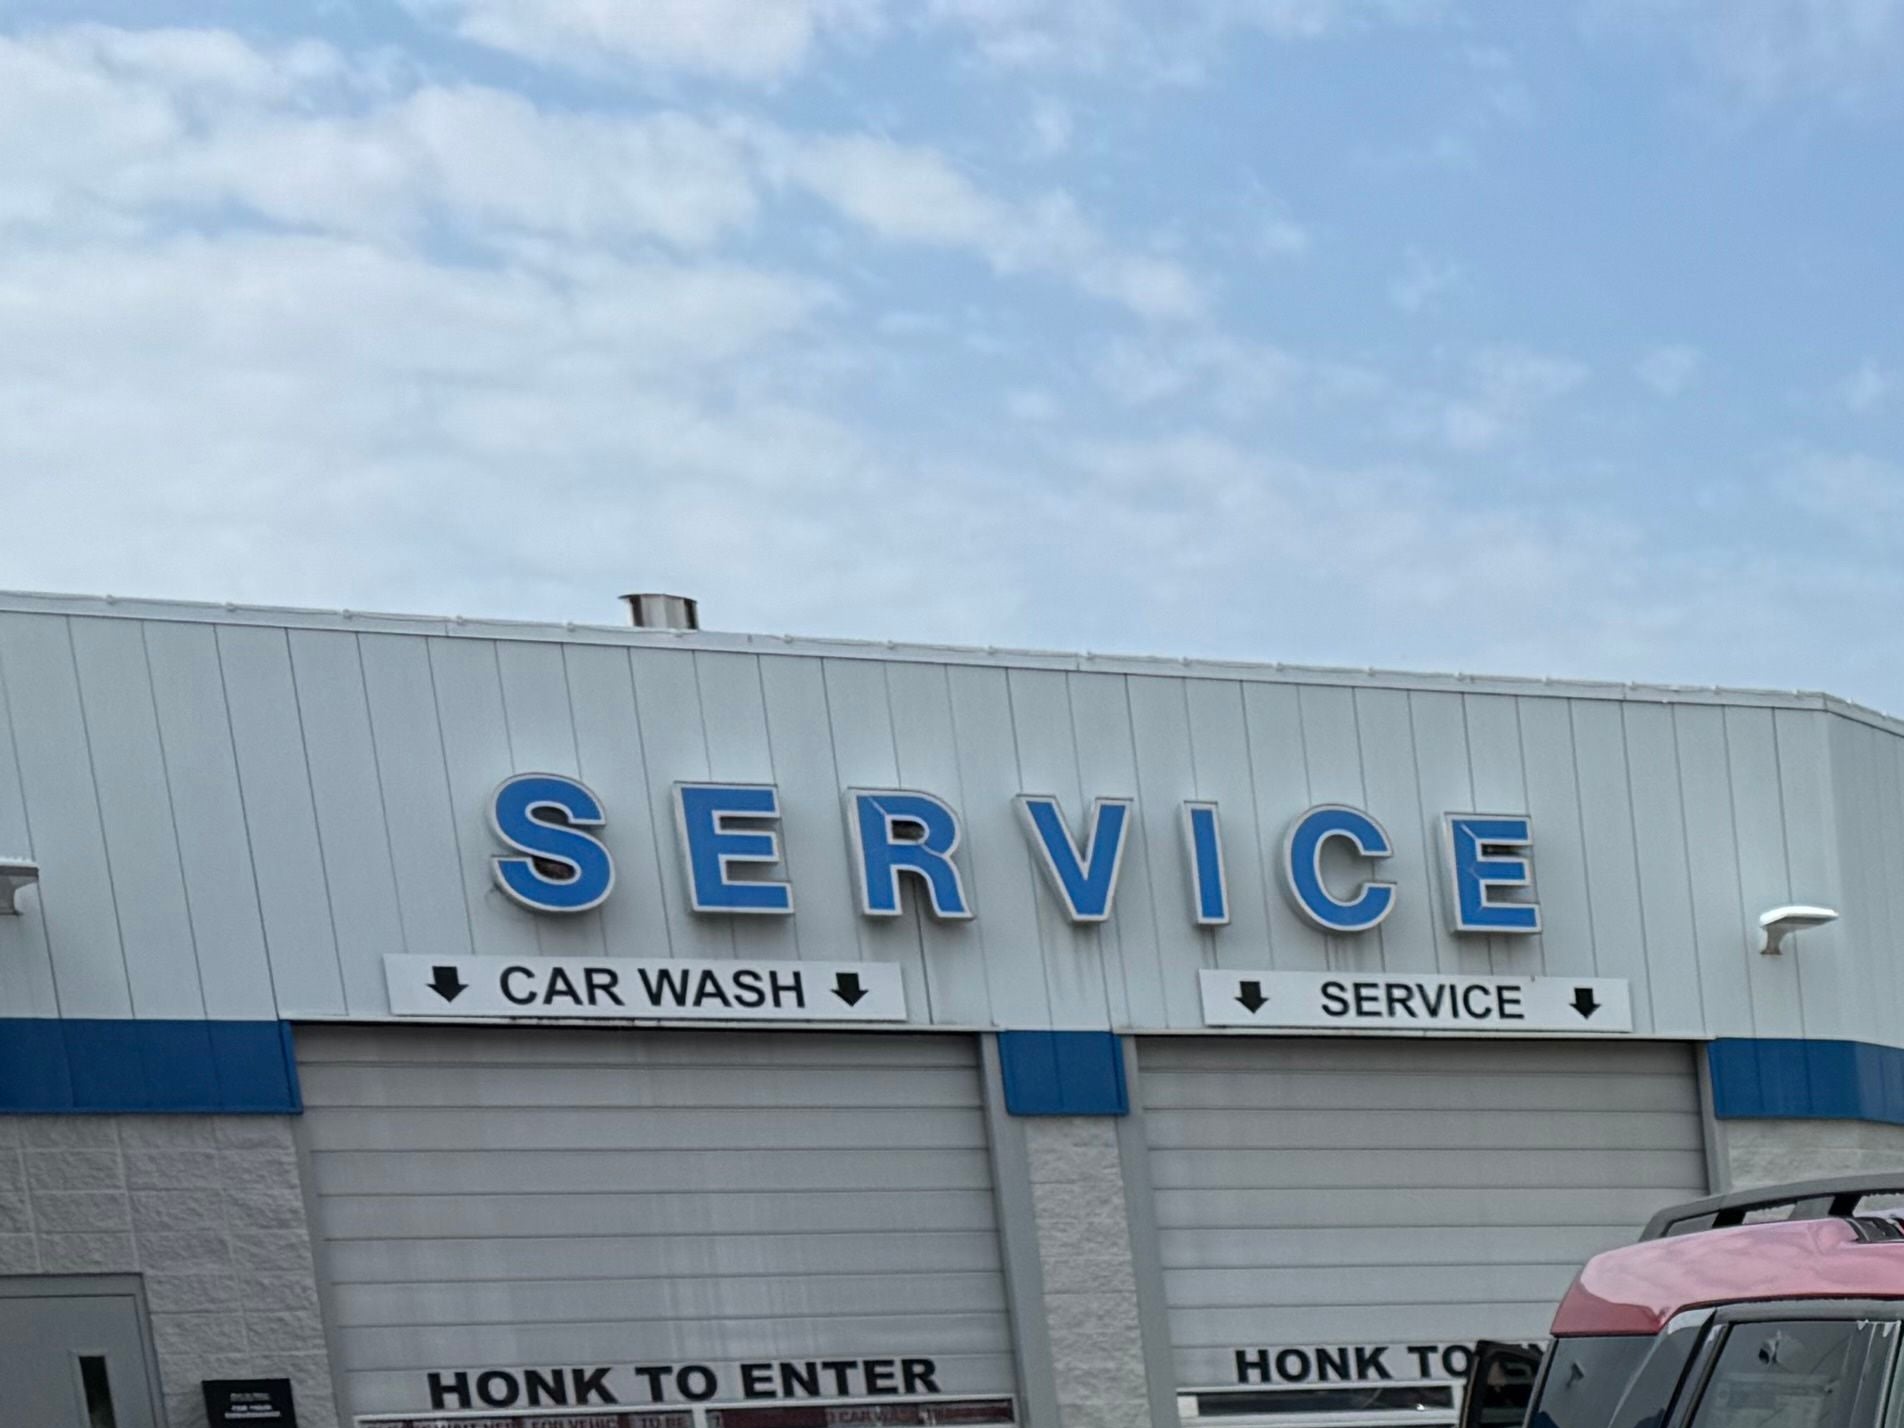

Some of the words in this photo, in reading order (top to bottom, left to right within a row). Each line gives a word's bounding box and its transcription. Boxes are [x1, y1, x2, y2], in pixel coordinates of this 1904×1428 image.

[487, 773, 1543, 933] SERVICE
[500, 966, 625, 1006] CAR
[638, 968, 806, 1009] WASH
[1321, 981, 1526, 1020] SERVICE
[427, 1366, 619, 1410] HONK
[635, 1364, 718, 1403] TO
[740, 1358, 941, 1400] ENTER
[1235, 1346, 1392, 1384] HONK
[1407, 1344, 1473, 1379] TO
